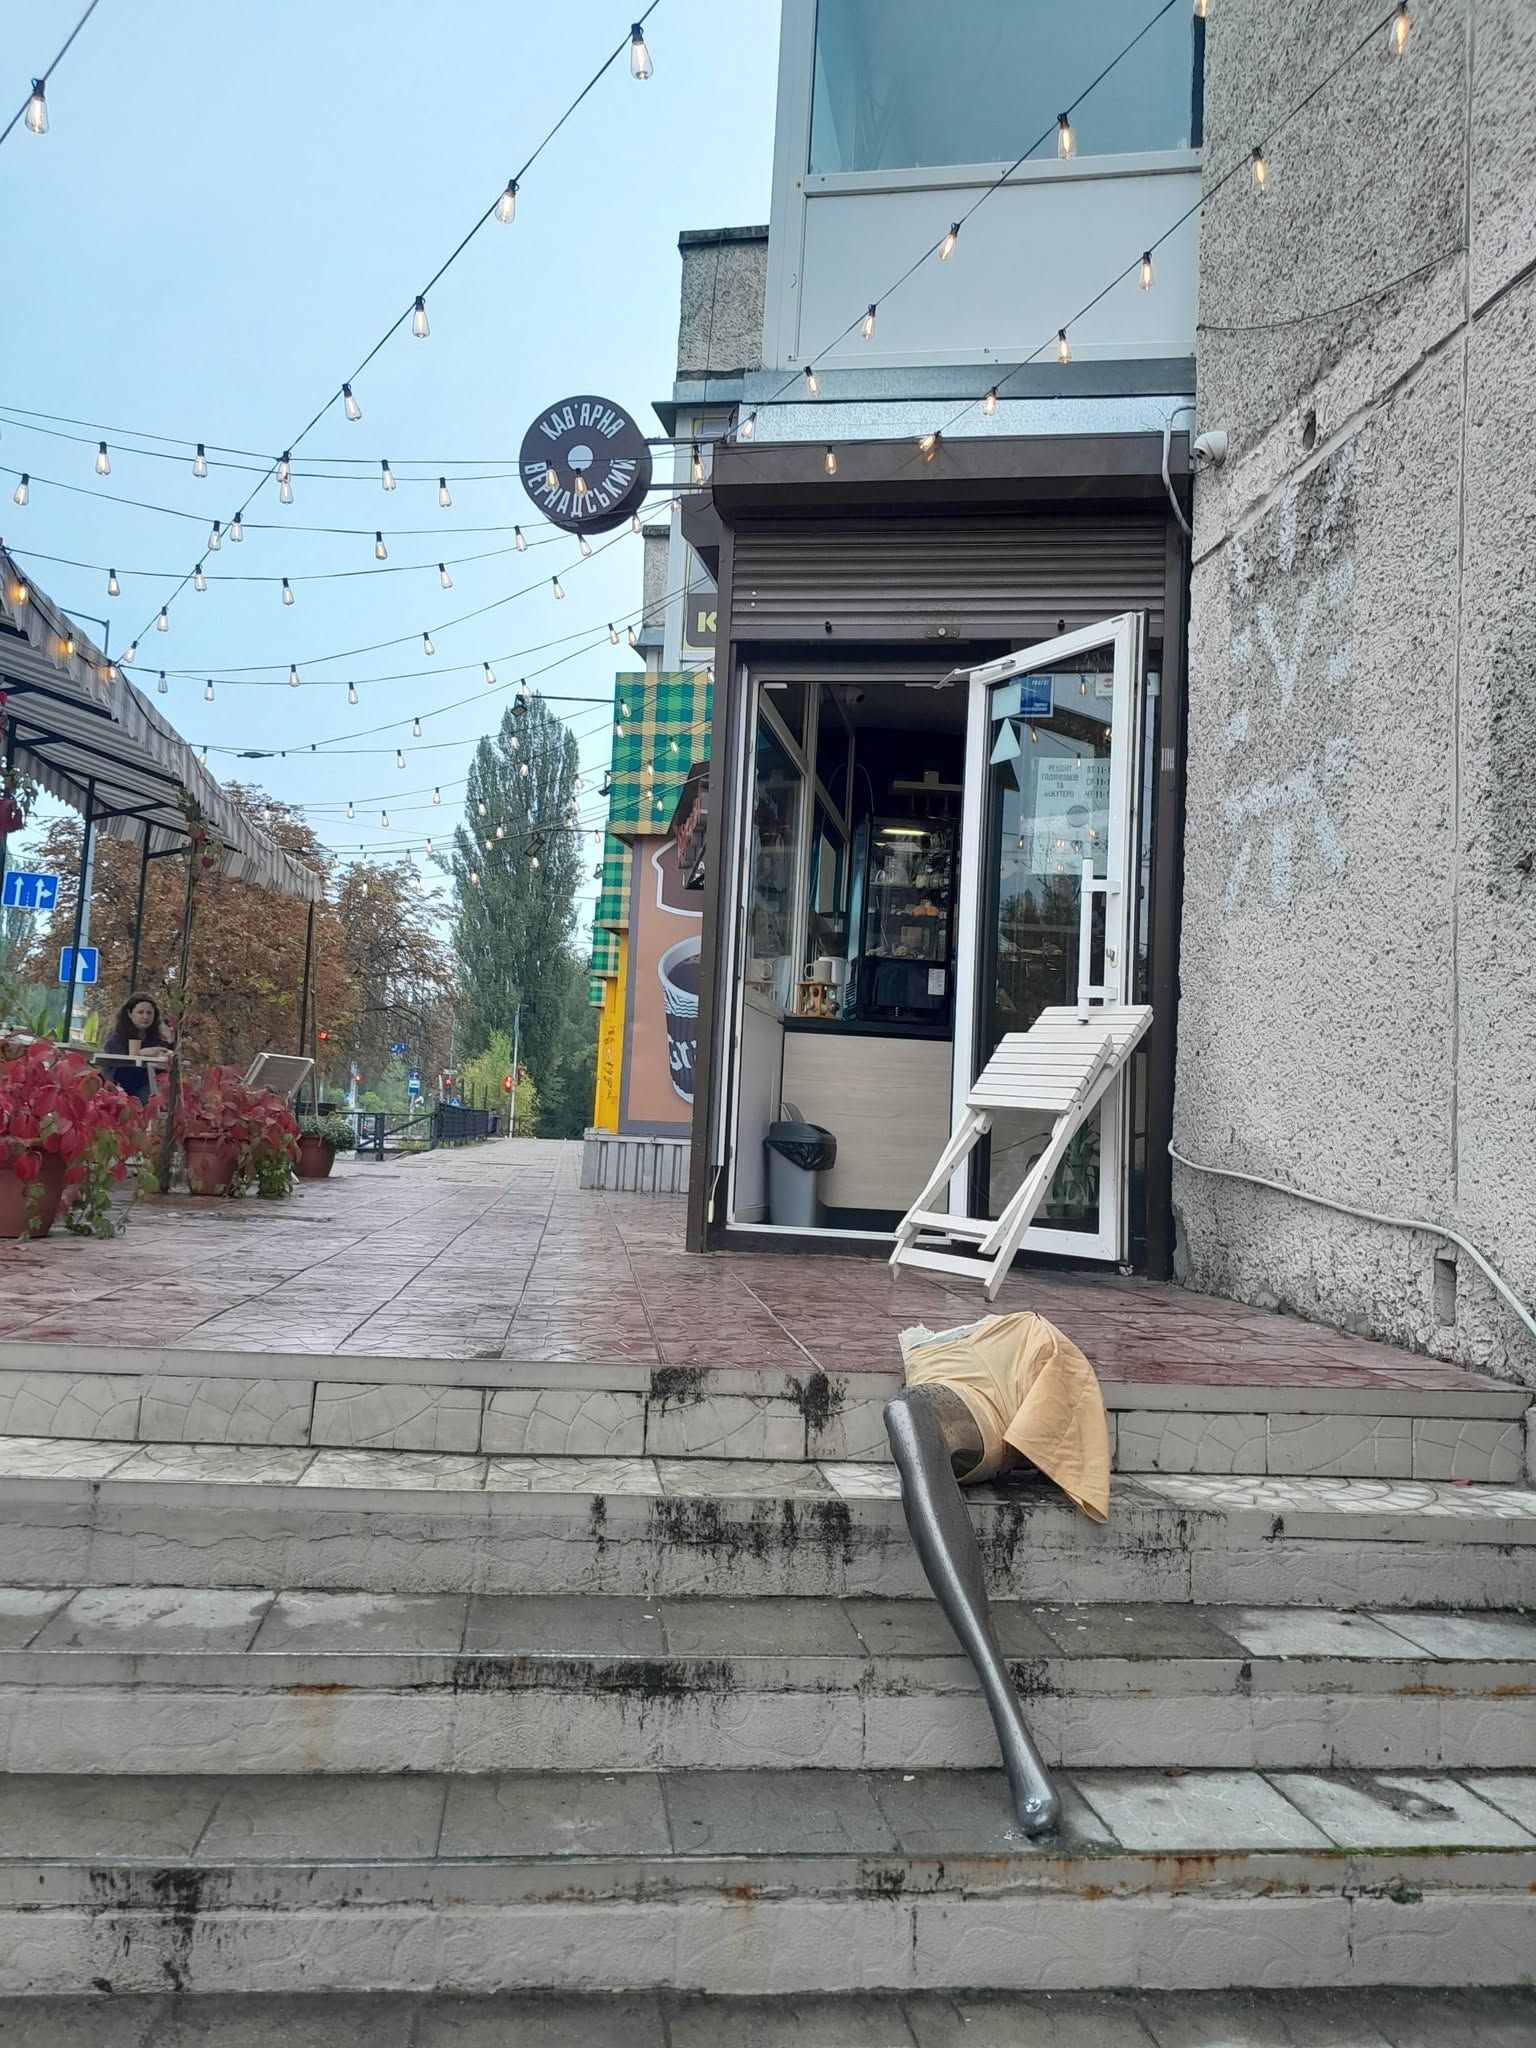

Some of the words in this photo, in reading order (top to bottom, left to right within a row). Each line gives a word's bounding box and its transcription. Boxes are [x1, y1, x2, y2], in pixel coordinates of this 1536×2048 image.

[539, 402, 626, 441] КАВ'ЯРНЯ
[524, 459, 637, 518] ВЕРНАДСЬКИЙ
[1056, 781, 1064, 789] ТА
